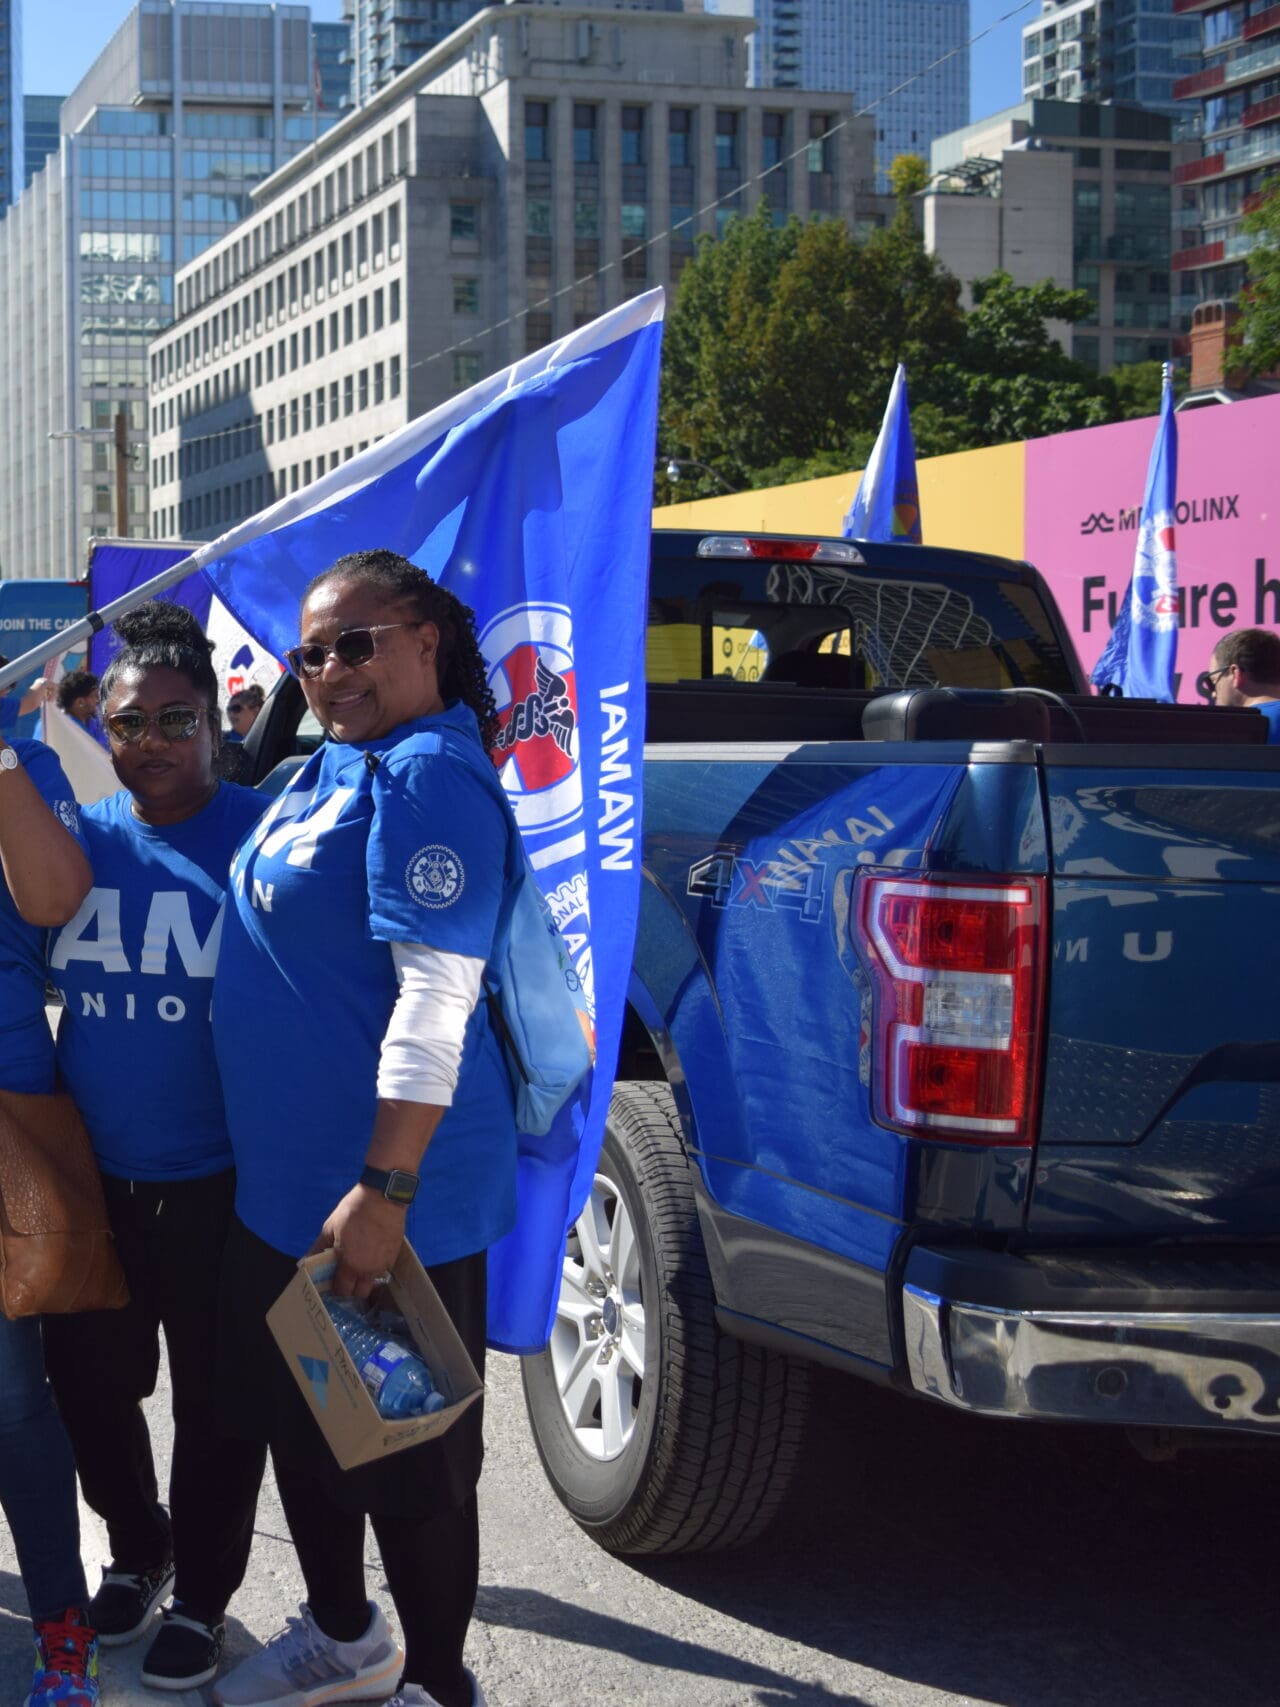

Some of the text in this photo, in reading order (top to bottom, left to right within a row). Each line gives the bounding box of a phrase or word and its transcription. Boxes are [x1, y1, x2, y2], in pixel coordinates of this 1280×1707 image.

[1118, 494, 1239, 531] MOLINX
[28, 618, 52, 631] THE
[598, 680, 636, 872] IAMAW
[50, 886, 227, 978] AM
[59, 988, 213, 1023] NIO
